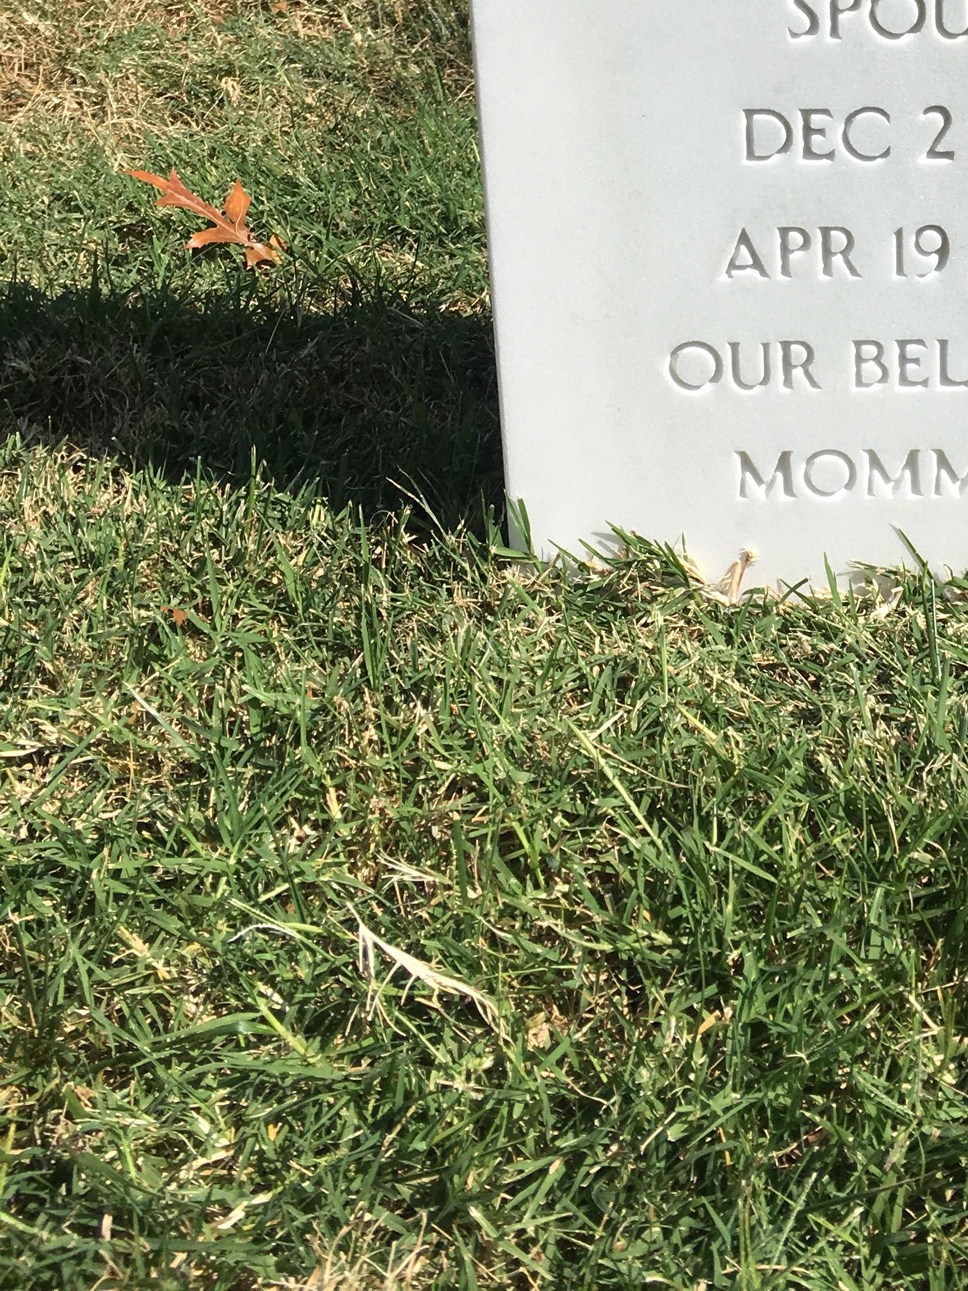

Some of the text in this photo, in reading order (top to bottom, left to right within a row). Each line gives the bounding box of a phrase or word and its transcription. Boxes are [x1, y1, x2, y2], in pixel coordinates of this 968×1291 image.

[742, 106, 892, 162] DEC
[917, 105, 956, 161] 2
[724, 225, 862, 278] APR
[893, 223, 951, 278] 19
[667, 339, 823, 391] OUR
